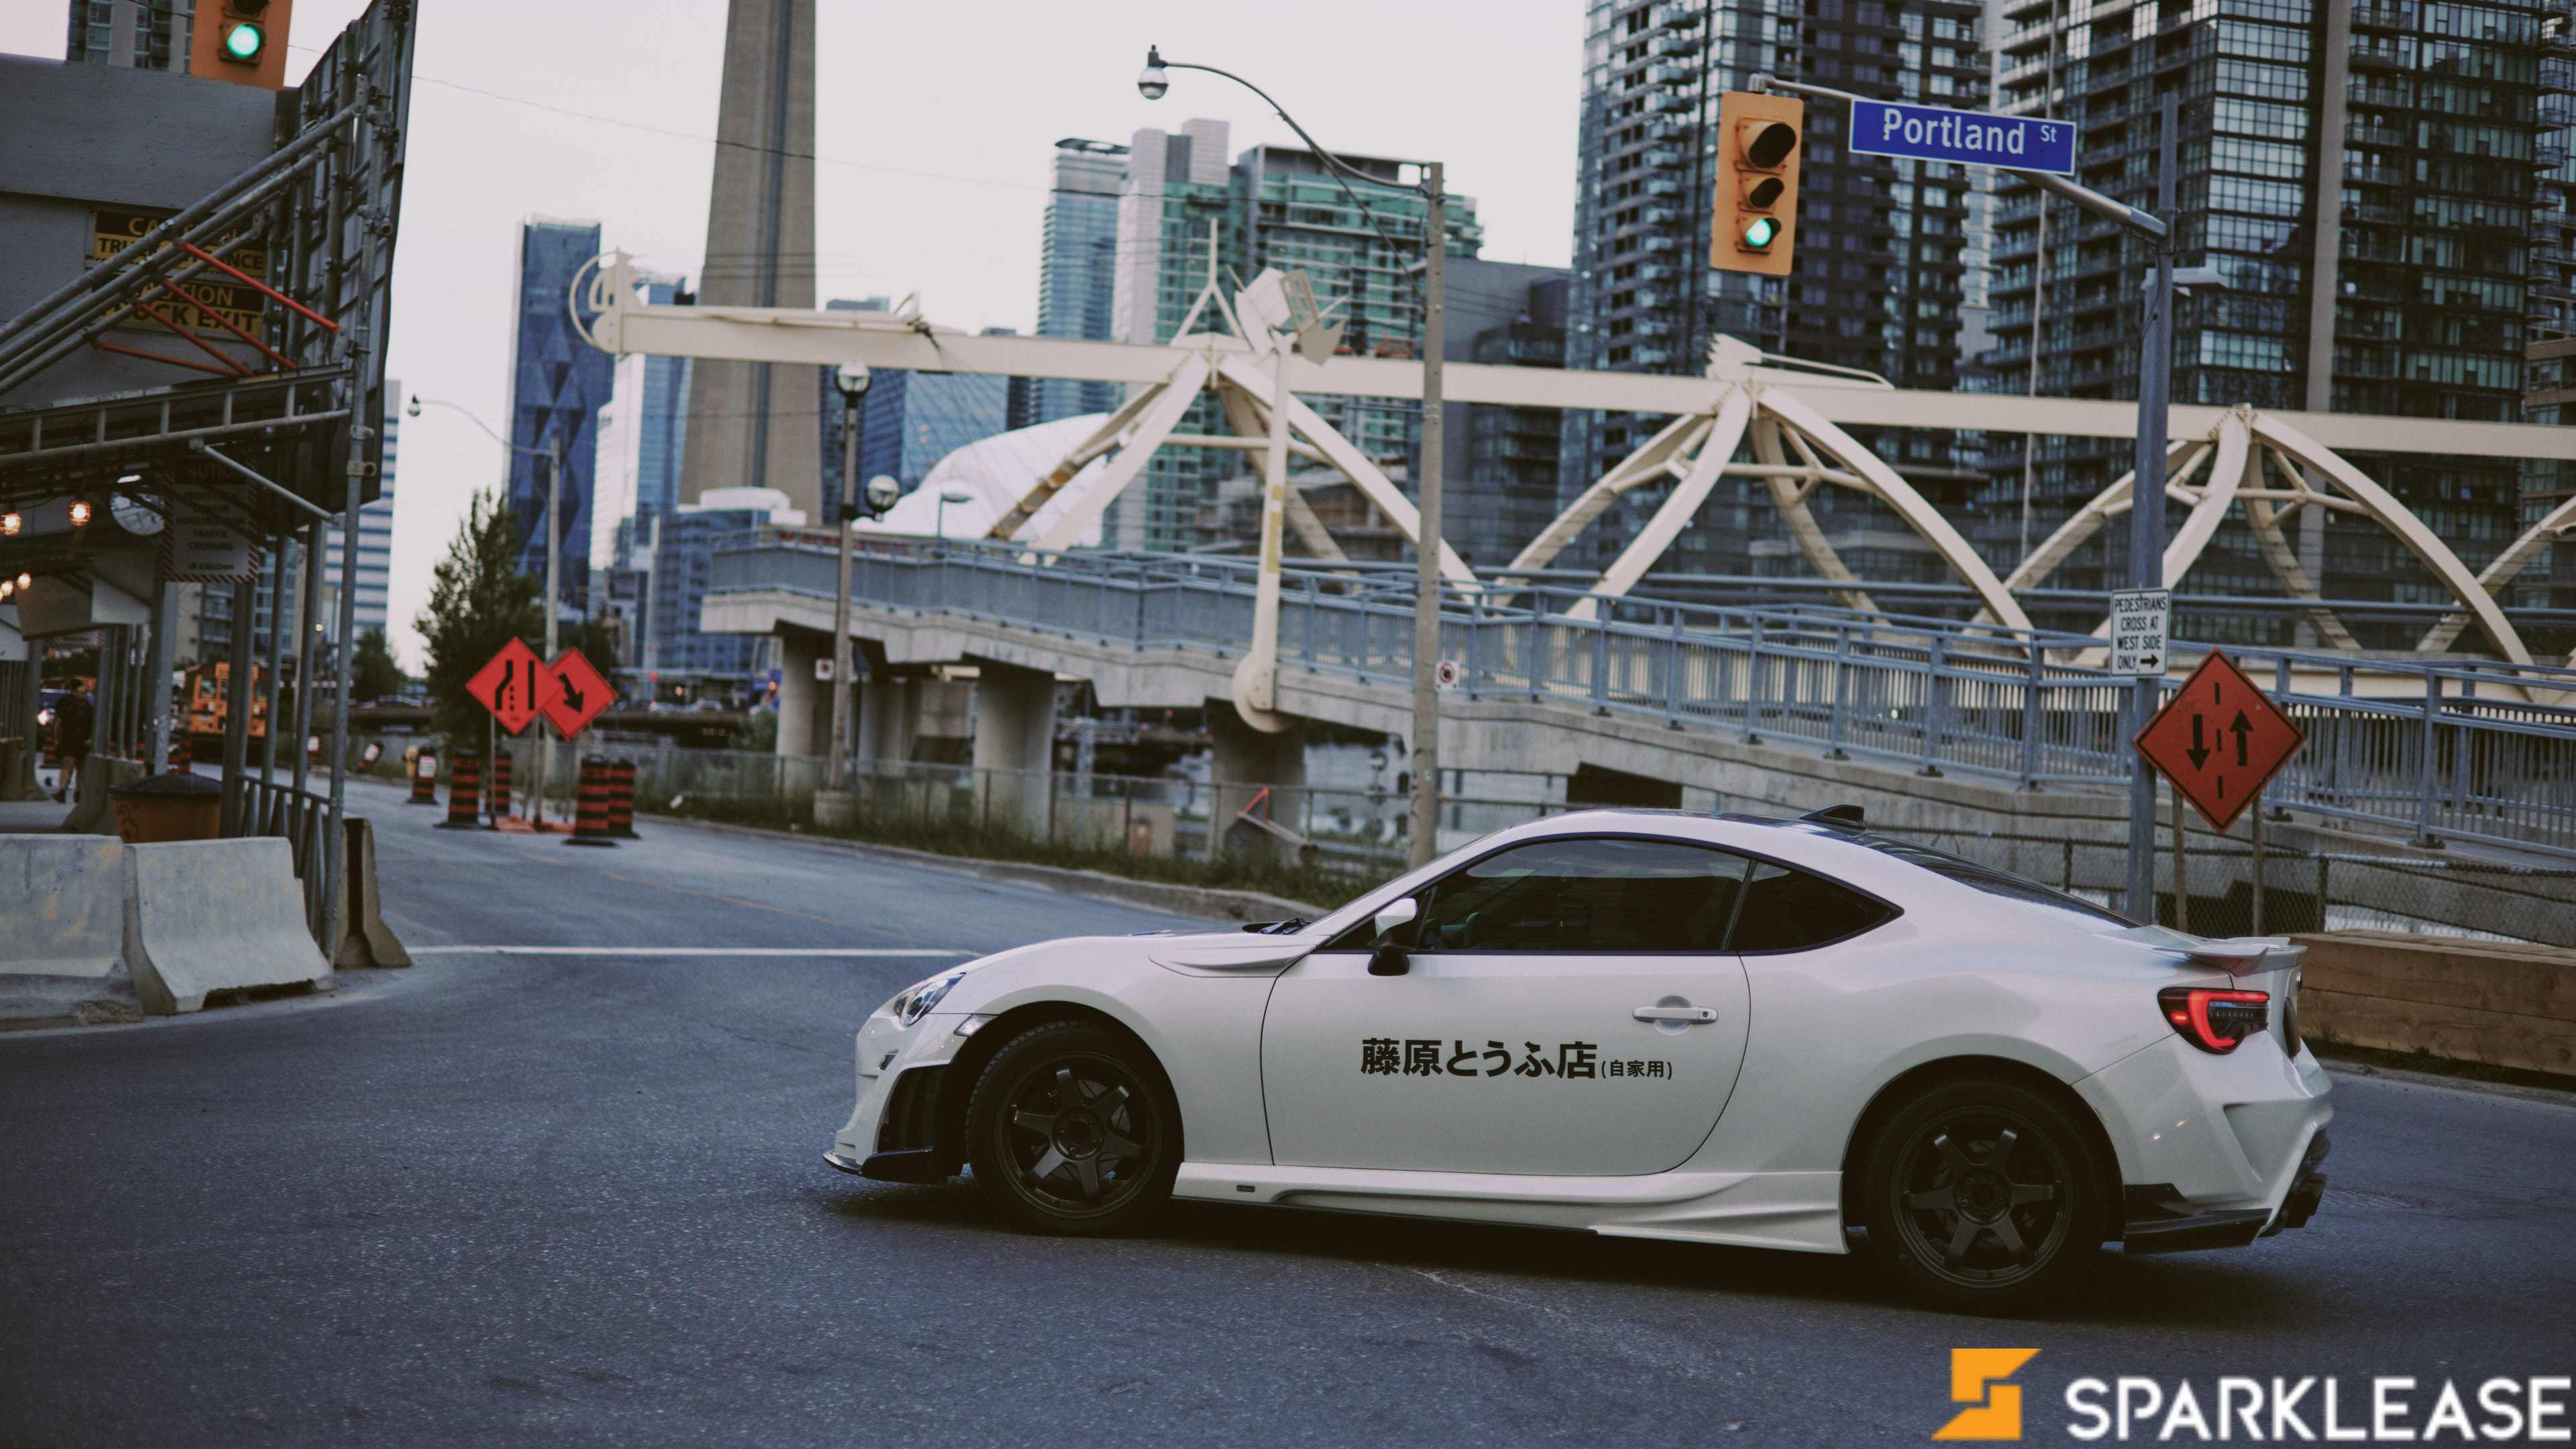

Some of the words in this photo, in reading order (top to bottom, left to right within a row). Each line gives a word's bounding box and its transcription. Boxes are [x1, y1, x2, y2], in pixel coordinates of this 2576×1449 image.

[1883, 108, 2025, 155] Portland
[2040, 125, 2057, 143] St
[2114, 596, 2167, 612] PEDESTRIANS
[2121, 616, 2147, 631] CROSS
[2149, 615, 2159, 630] AT
[2117, 635, 2139, 651] WEST
[2142, 635, 2162, 650] SIDE
[2117, 654, 2137, 669] ONLY
